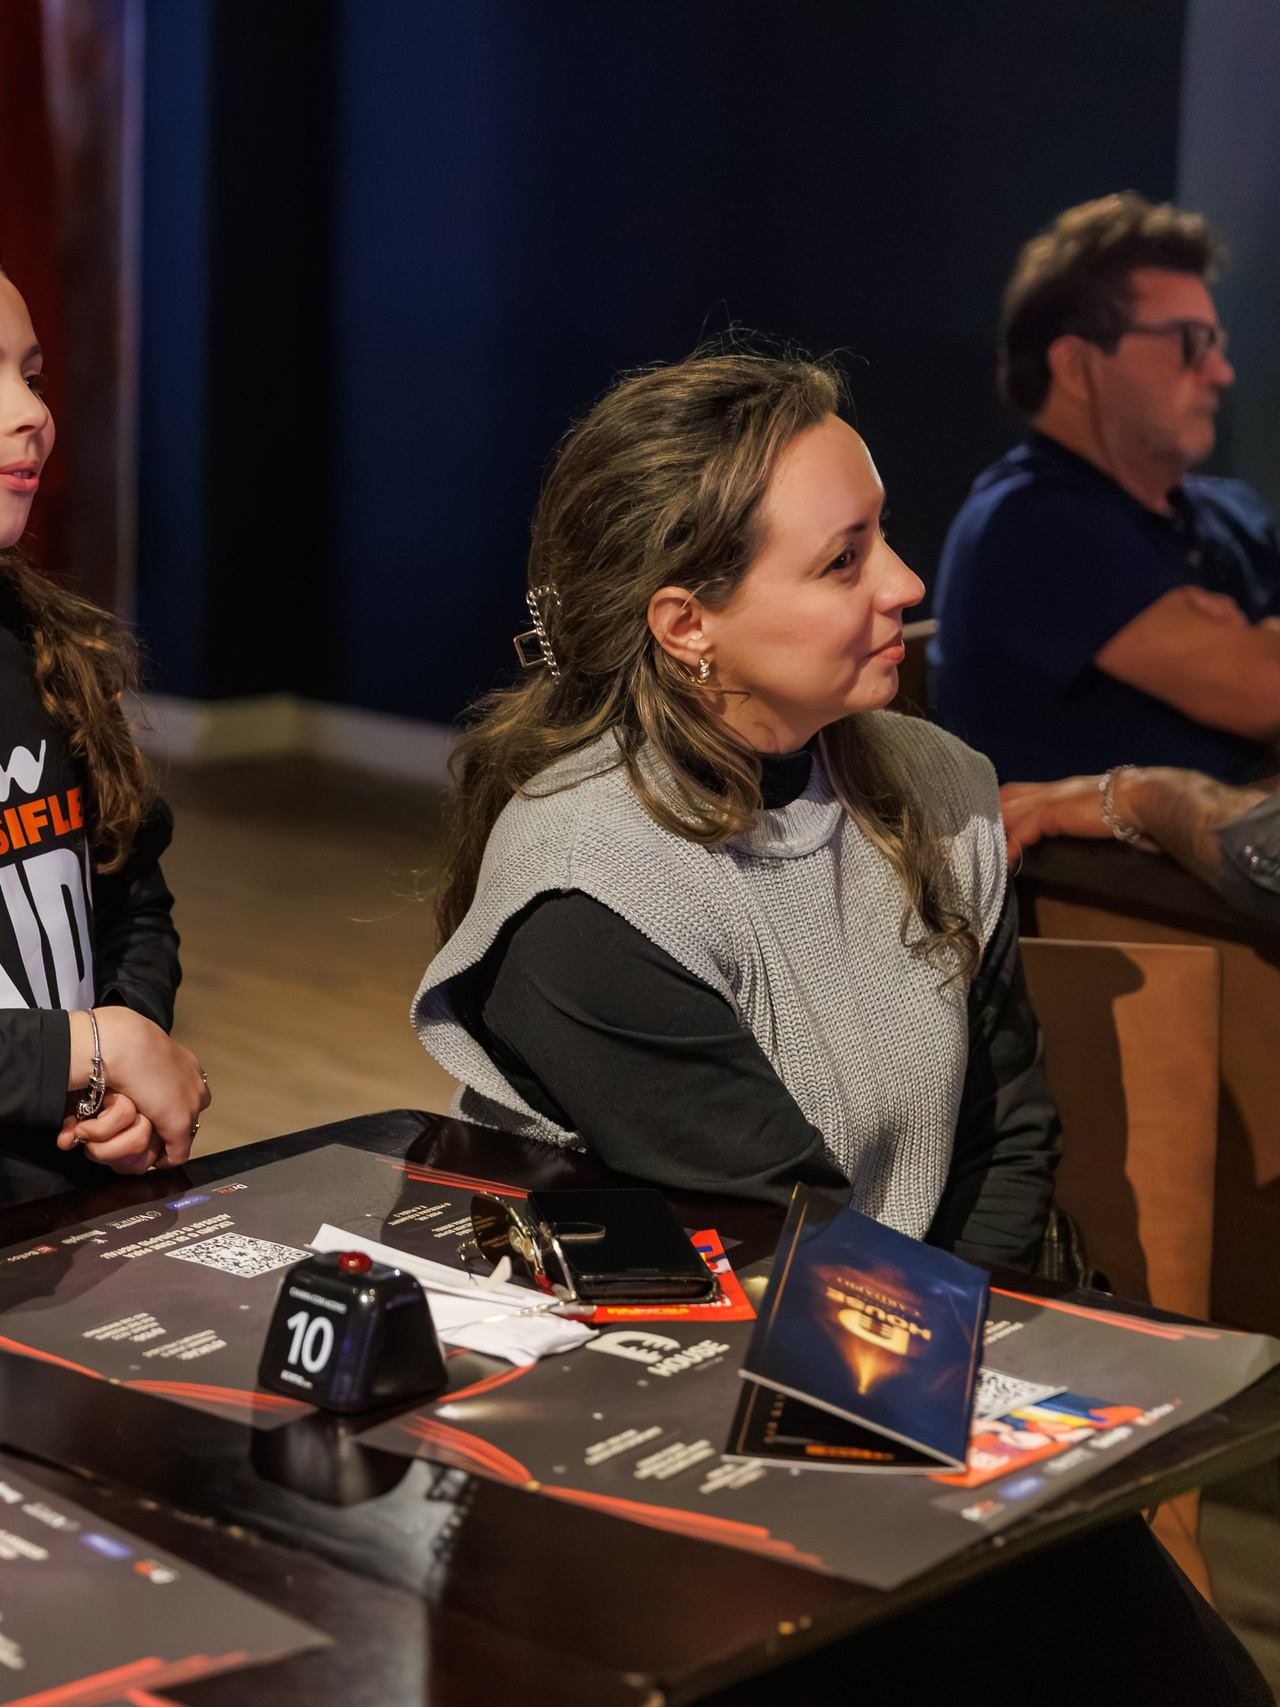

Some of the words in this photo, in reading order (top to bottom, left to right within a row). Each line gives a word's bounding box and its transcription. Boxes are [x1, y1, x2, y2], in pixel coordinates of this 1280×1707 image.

[825, 1286, 932, 1341] HOUSE
[287, 1310, 335, 1374] 10
[647, 1339, 731, 1378] HOUSE
